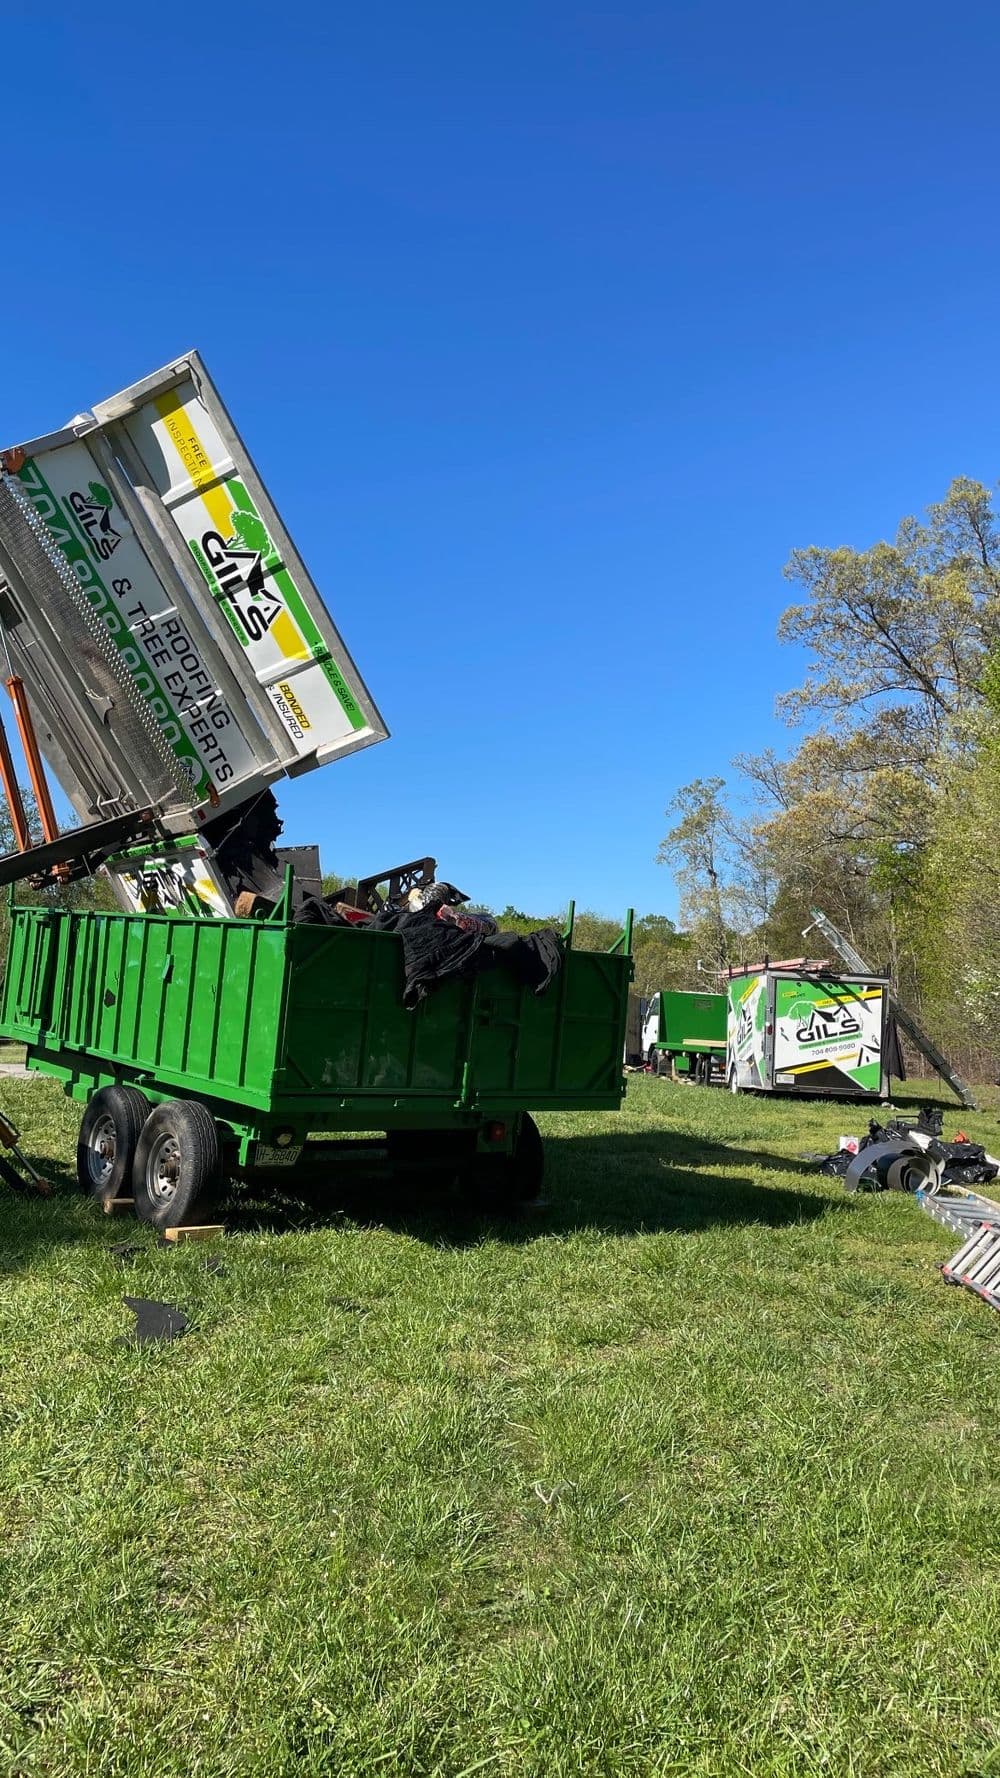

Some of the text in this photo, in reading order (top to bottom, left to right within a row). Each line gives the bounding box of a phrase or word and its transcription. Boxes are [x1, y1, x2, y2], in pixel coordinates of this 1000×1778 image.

[187, 436, 208, 468] FREE
[69, 491, 113, 560] GILS
[201, 530, 269, 641] GILS
[111, 577, 234, 783] & TREE EXPERTS
[161, 617, 230, 730] ROOFING
[273, 693, 304, 739] INSURED
[279, 684, 311, 729] BONDED
[337, 687, 355, 712] SAVE!
[796, 1018, 861, 1042] GILS
